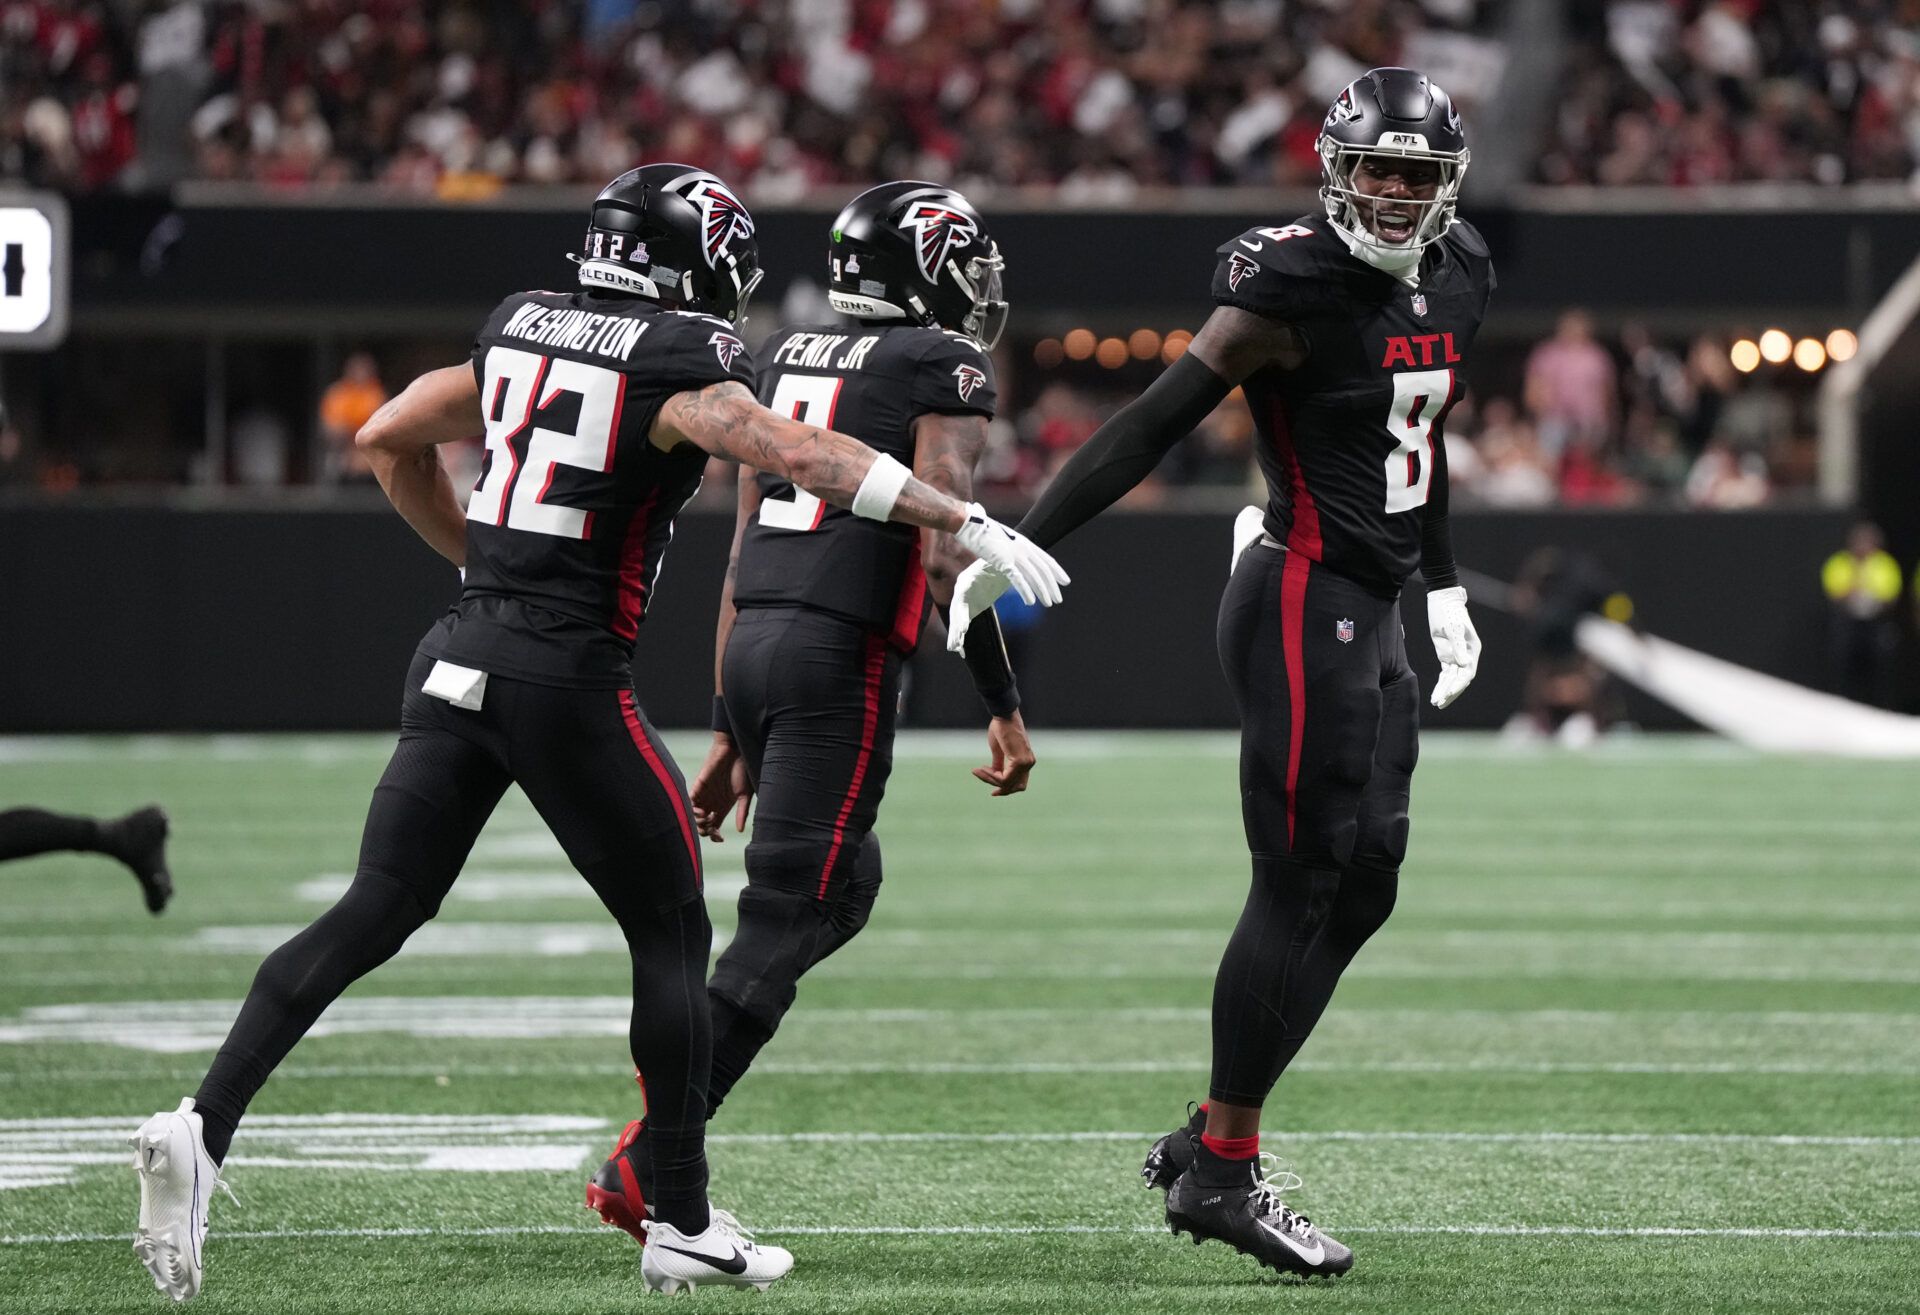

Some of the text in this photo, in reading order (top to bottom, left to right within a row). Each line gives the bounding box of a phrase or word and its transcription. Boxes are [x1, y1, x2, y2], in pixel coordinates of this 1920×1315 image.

[1392, 134, 1418, 144] ATL
[592, 232, 624, 261] 82
[1256, 224, 1315, 243] 8
[578, 268, 645, 292] ALCONS
[833, 258, 842, 282] 9
[833, 299, 874, 313] CONS
[502, 301, 650, 362] WASHINGTON
[774, 332, 880, 370] PENIX JR
[1382, 332, 1461, 368] ATL
[466, 346, 628, 540] 82
[1384, 368, 1455, 514] 8
